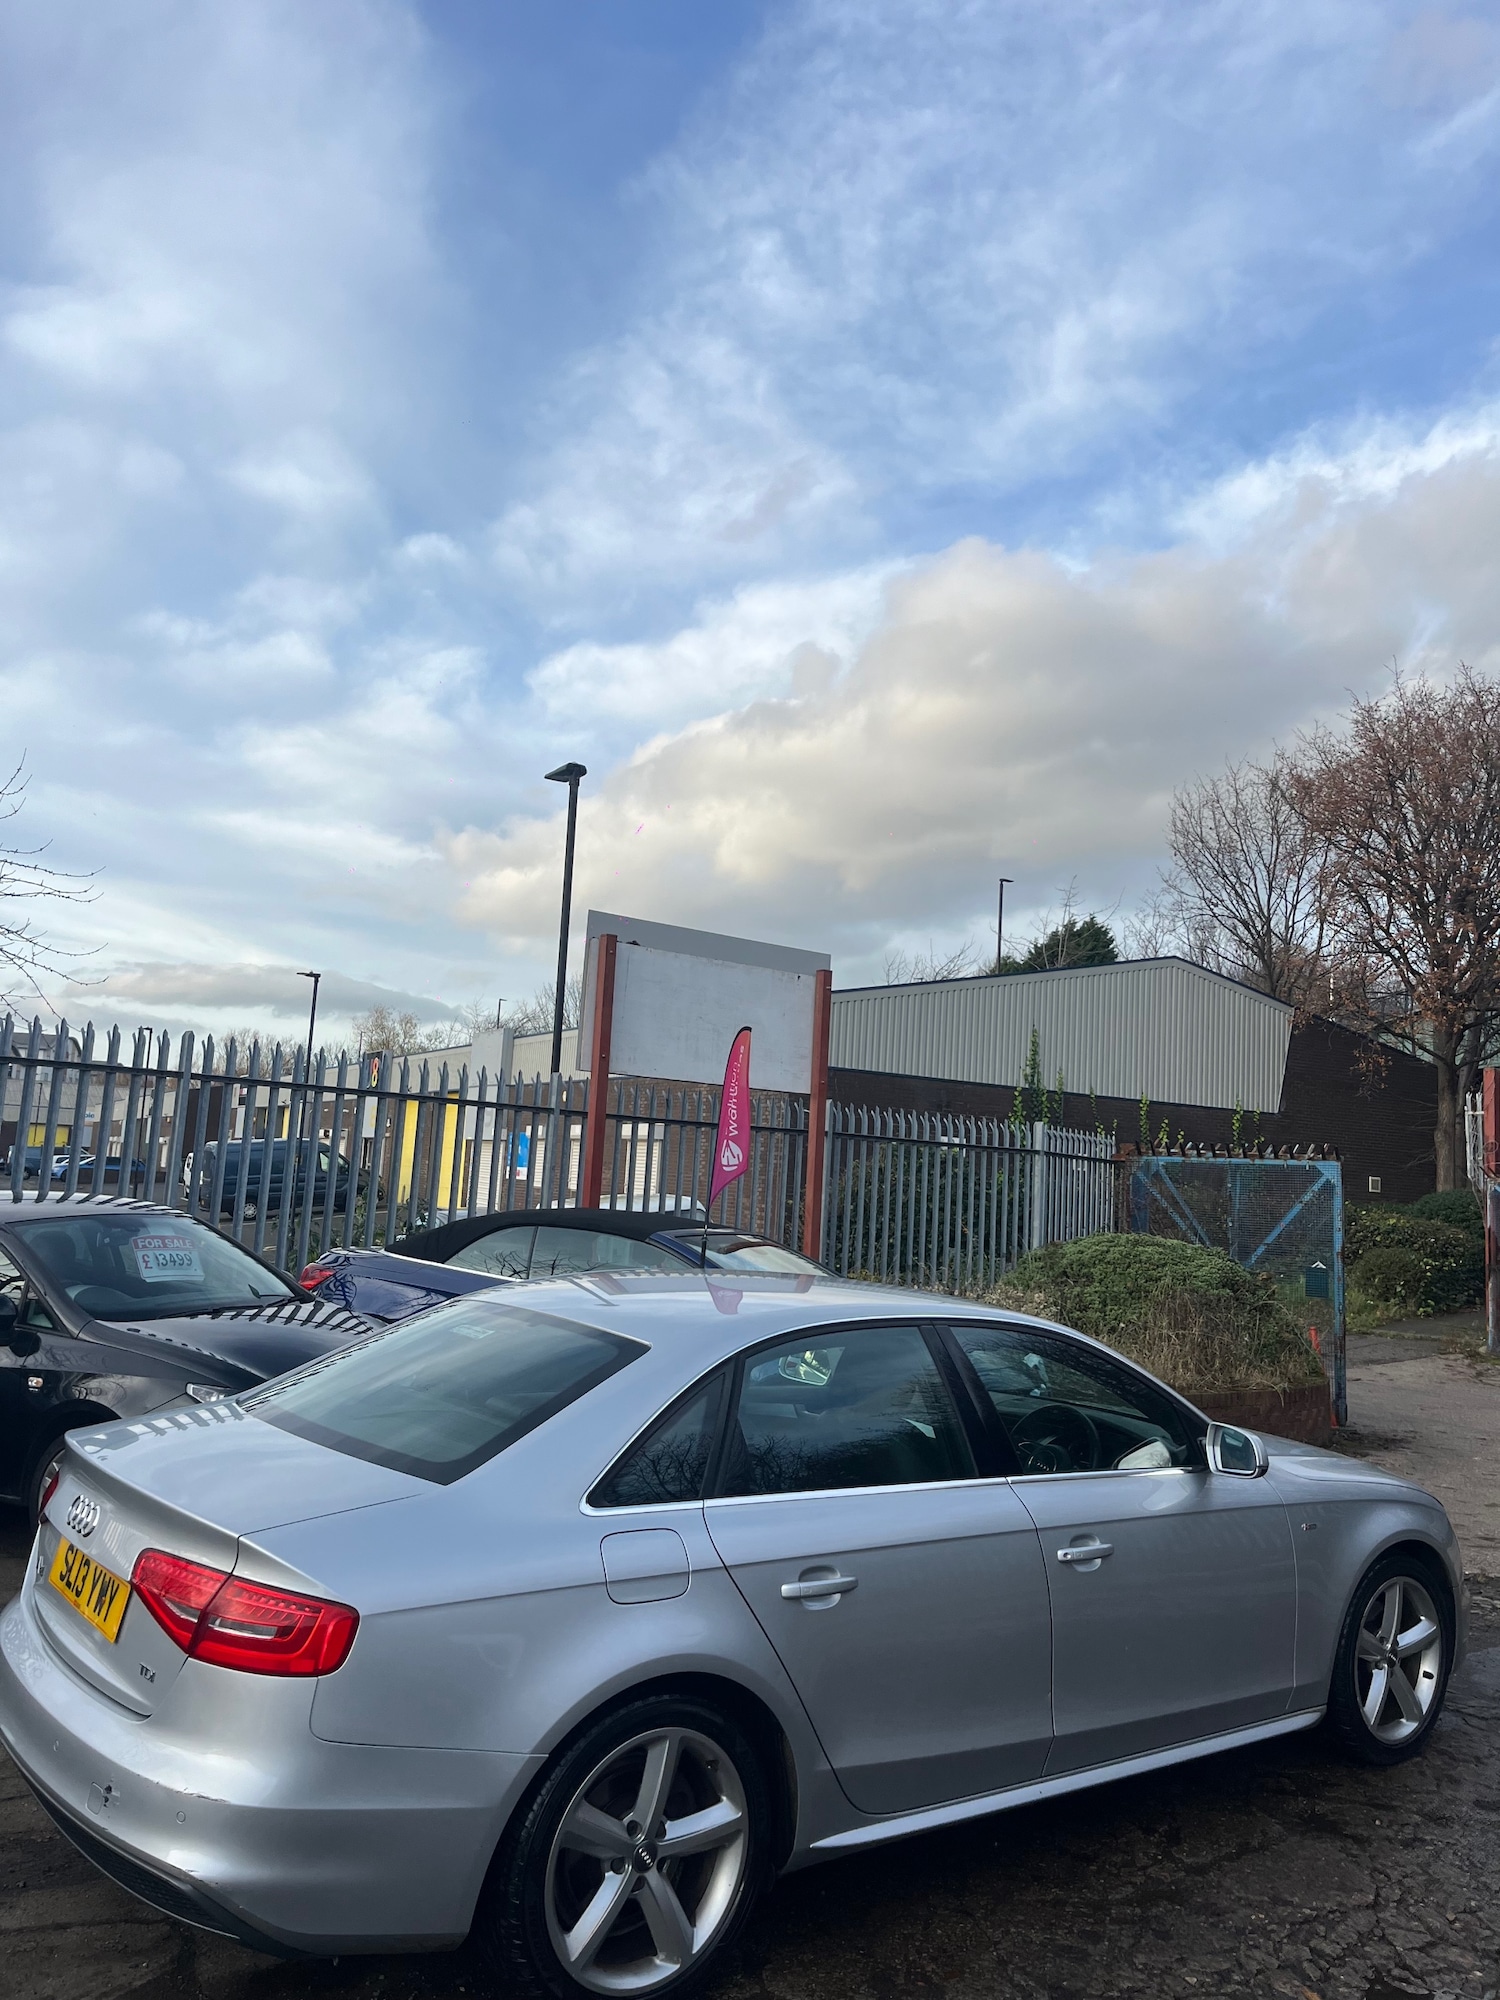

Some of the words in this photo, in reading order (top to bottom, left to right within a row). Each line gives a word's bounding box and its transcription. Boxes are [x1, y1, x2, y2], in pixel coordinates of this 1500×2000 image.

[137, 1239, 163, 1249] FOR
[165, 1239, 193, 1249] SALE
[59, 1543, 91, 1598] SL13
